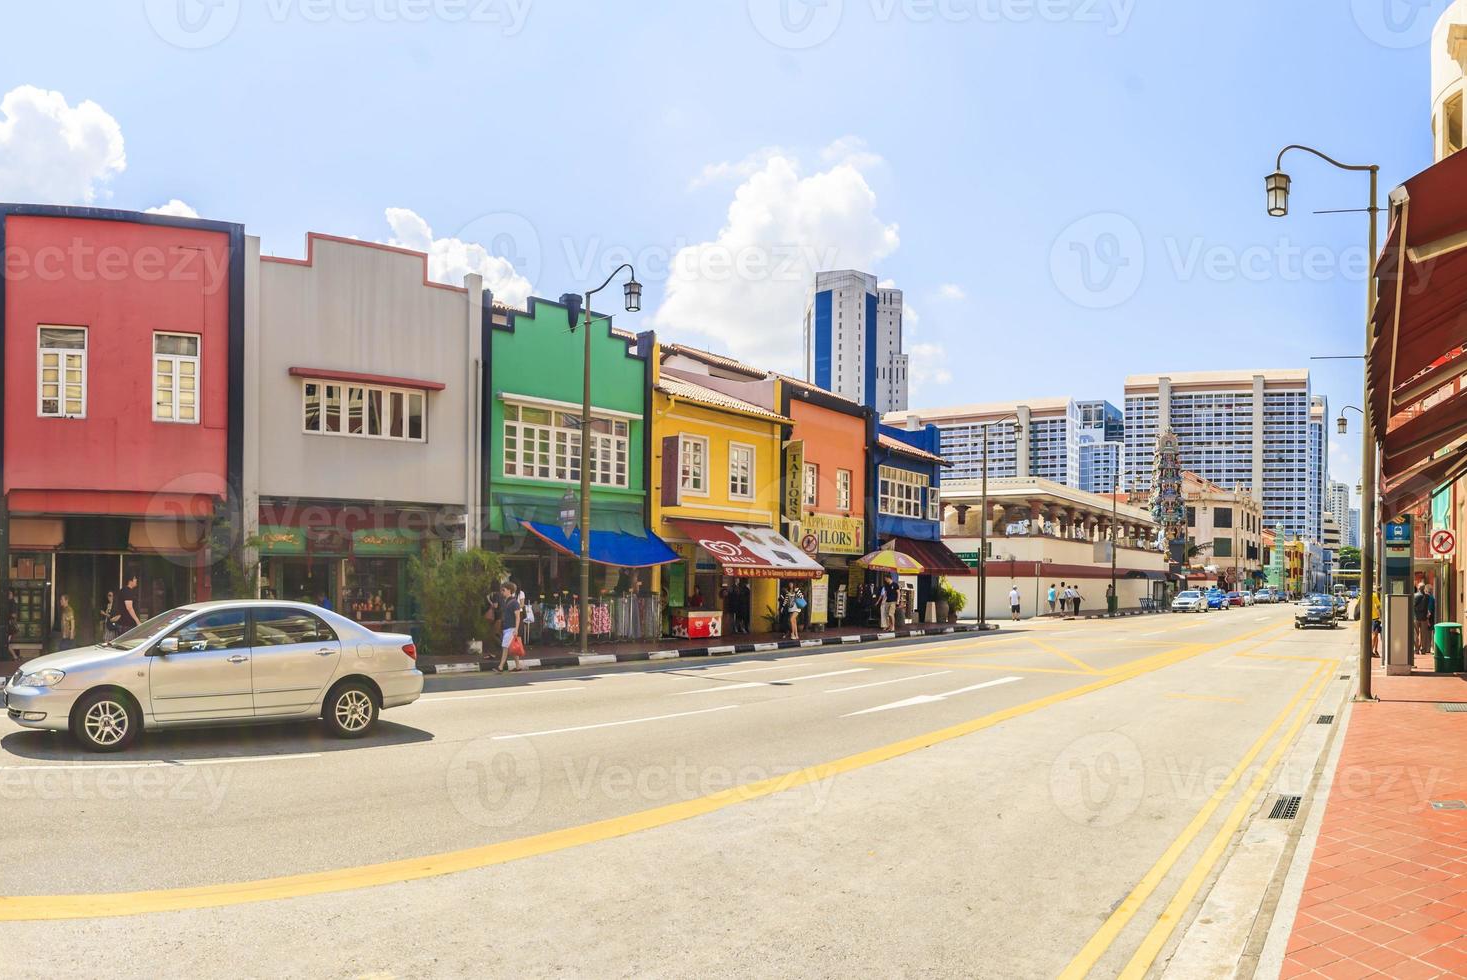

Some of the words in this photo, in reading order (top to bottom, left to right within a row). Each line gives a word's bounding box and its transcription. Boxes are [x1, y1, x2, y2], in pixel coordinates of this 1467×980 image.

[788, 453, 800, 515] TAILORS
[805, 528, 852, 546] TILORS
[719, 555, 757, 564] WALL'S
